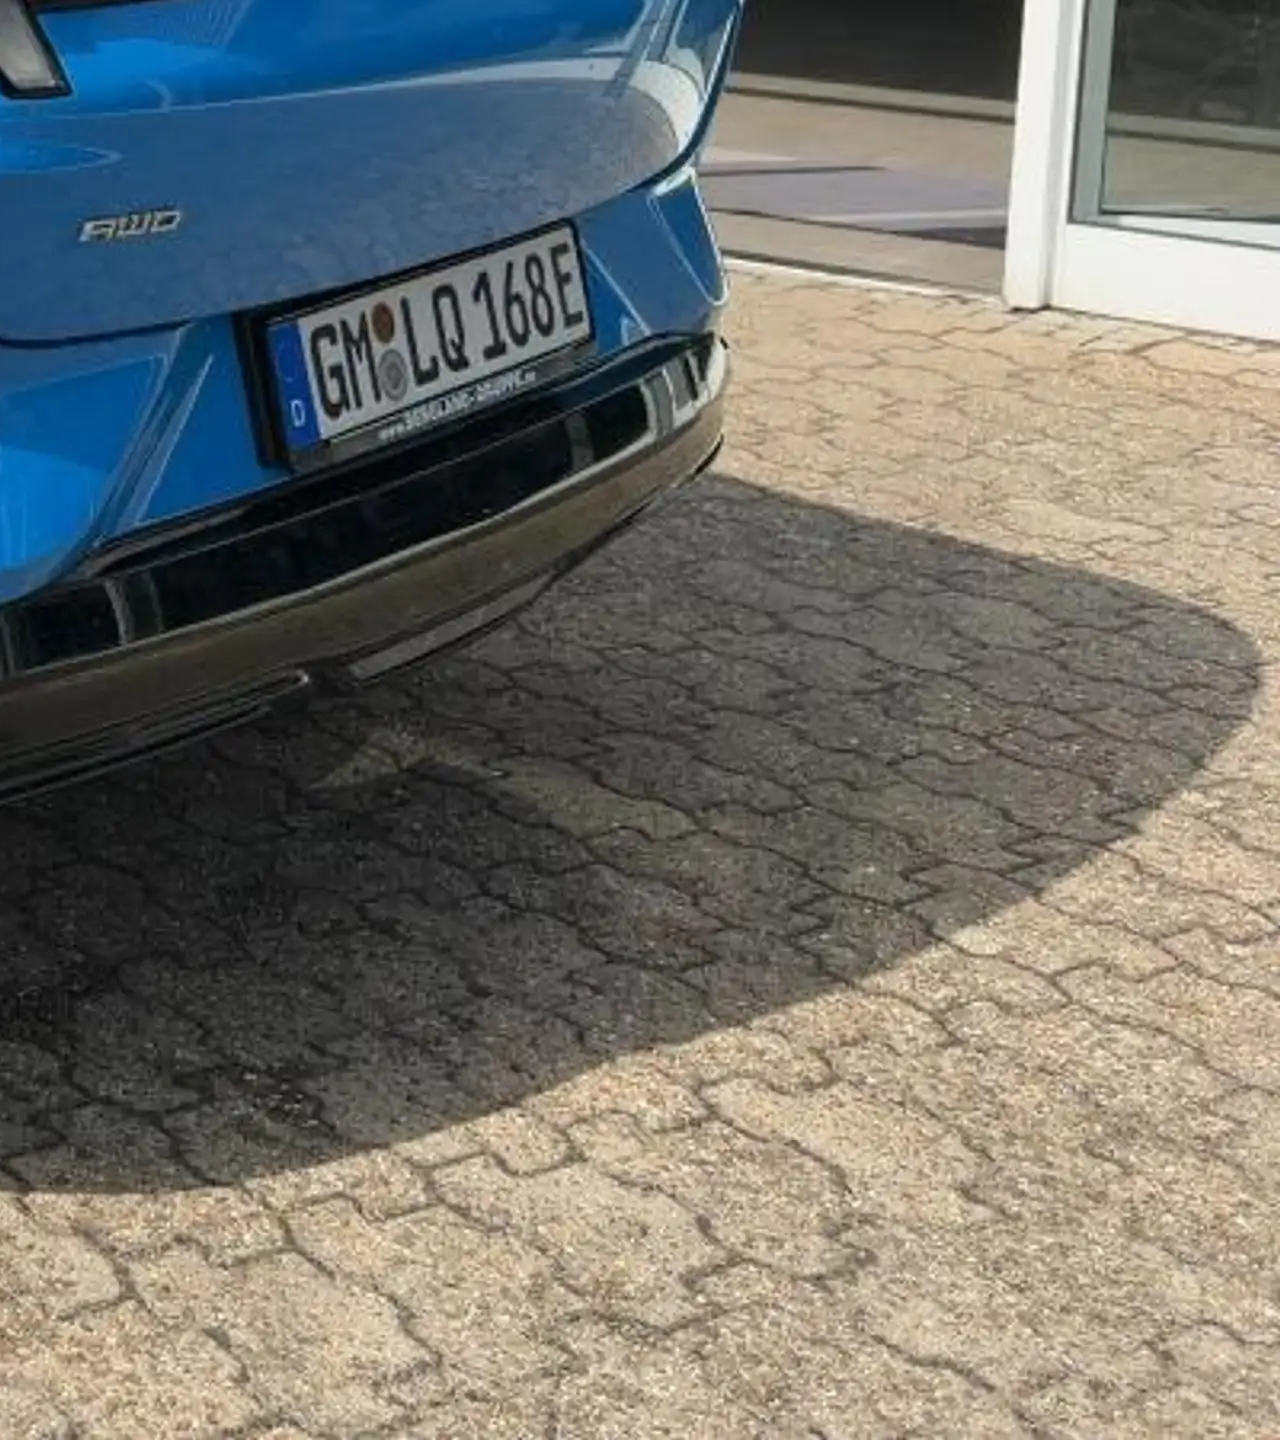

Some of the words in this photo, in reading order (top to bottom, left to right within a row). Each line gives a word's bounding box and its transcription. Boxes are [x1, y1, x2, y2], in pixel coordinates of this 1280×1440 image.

[78, 210, 180, 243] AWD
[309, 310, 382, 419] GM
[400, 282, 470, 387] LQ
[472, 242, 584, 361] 168E
